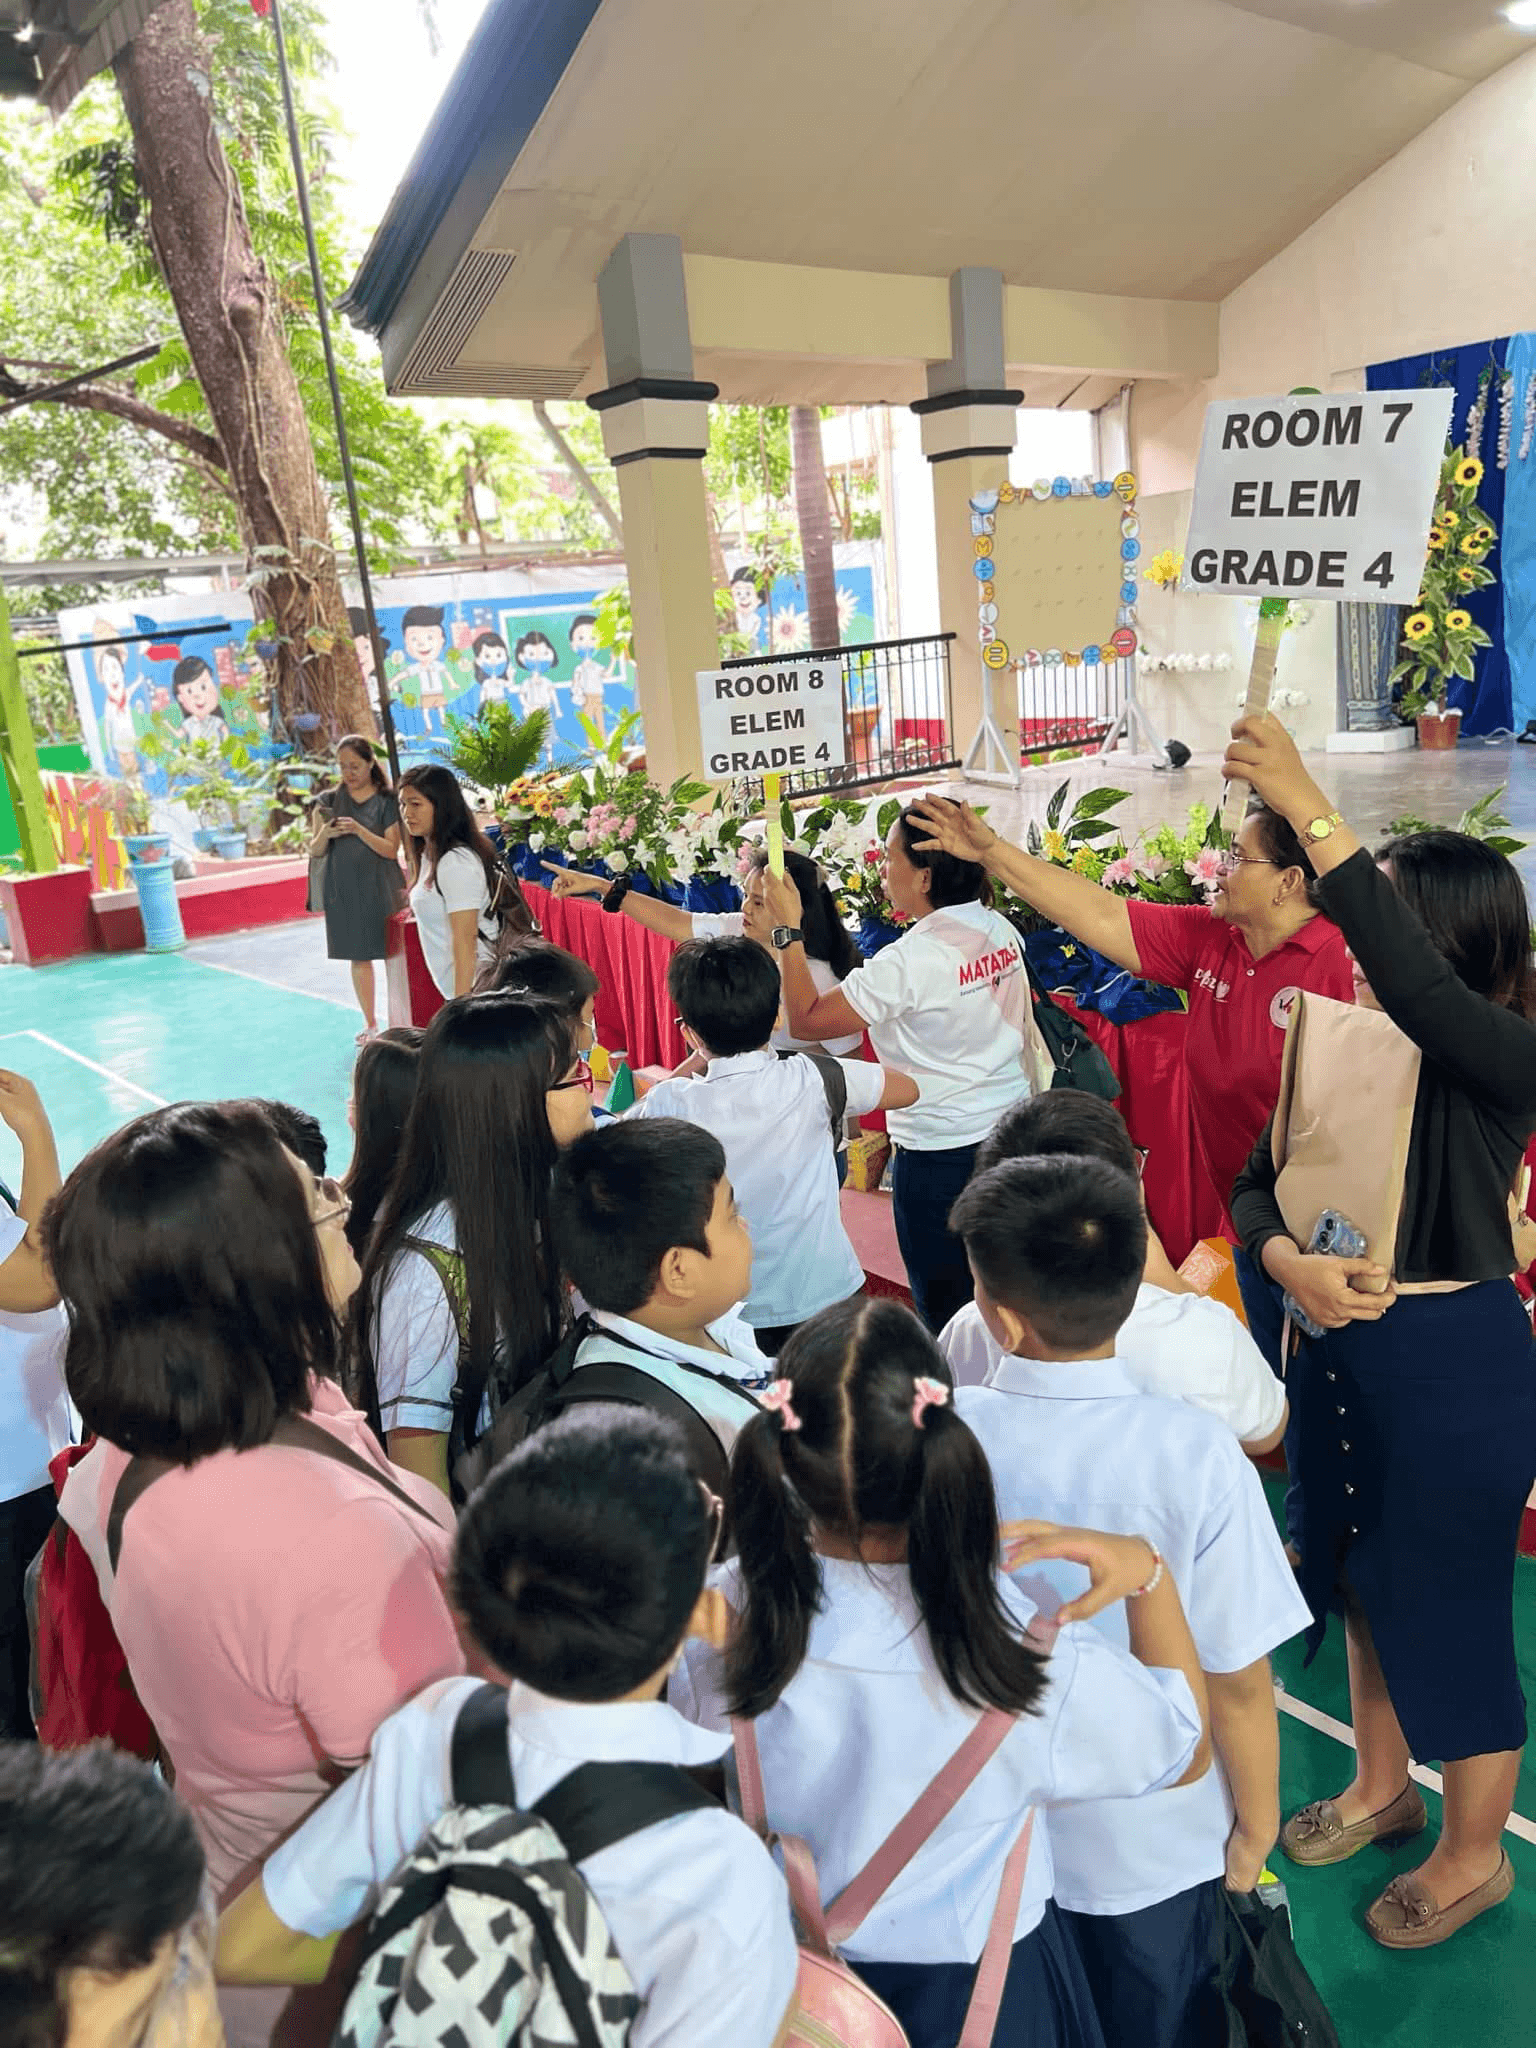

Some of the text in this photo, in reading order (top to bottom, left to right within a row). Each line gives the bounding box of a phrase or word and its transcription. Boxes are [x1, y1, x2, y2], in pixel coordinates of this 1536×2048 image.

[1222, 403, 1413, 450] ROOM 7
[1230, 479, 1361, 518] ELEM
[1190, 549, 1394, 589] GRADE 4
[715, 669, 824, 700] ROOM 8
[730, 708, 805, 736] ELEM
[710, 742, 831, 774] GRADE 4
